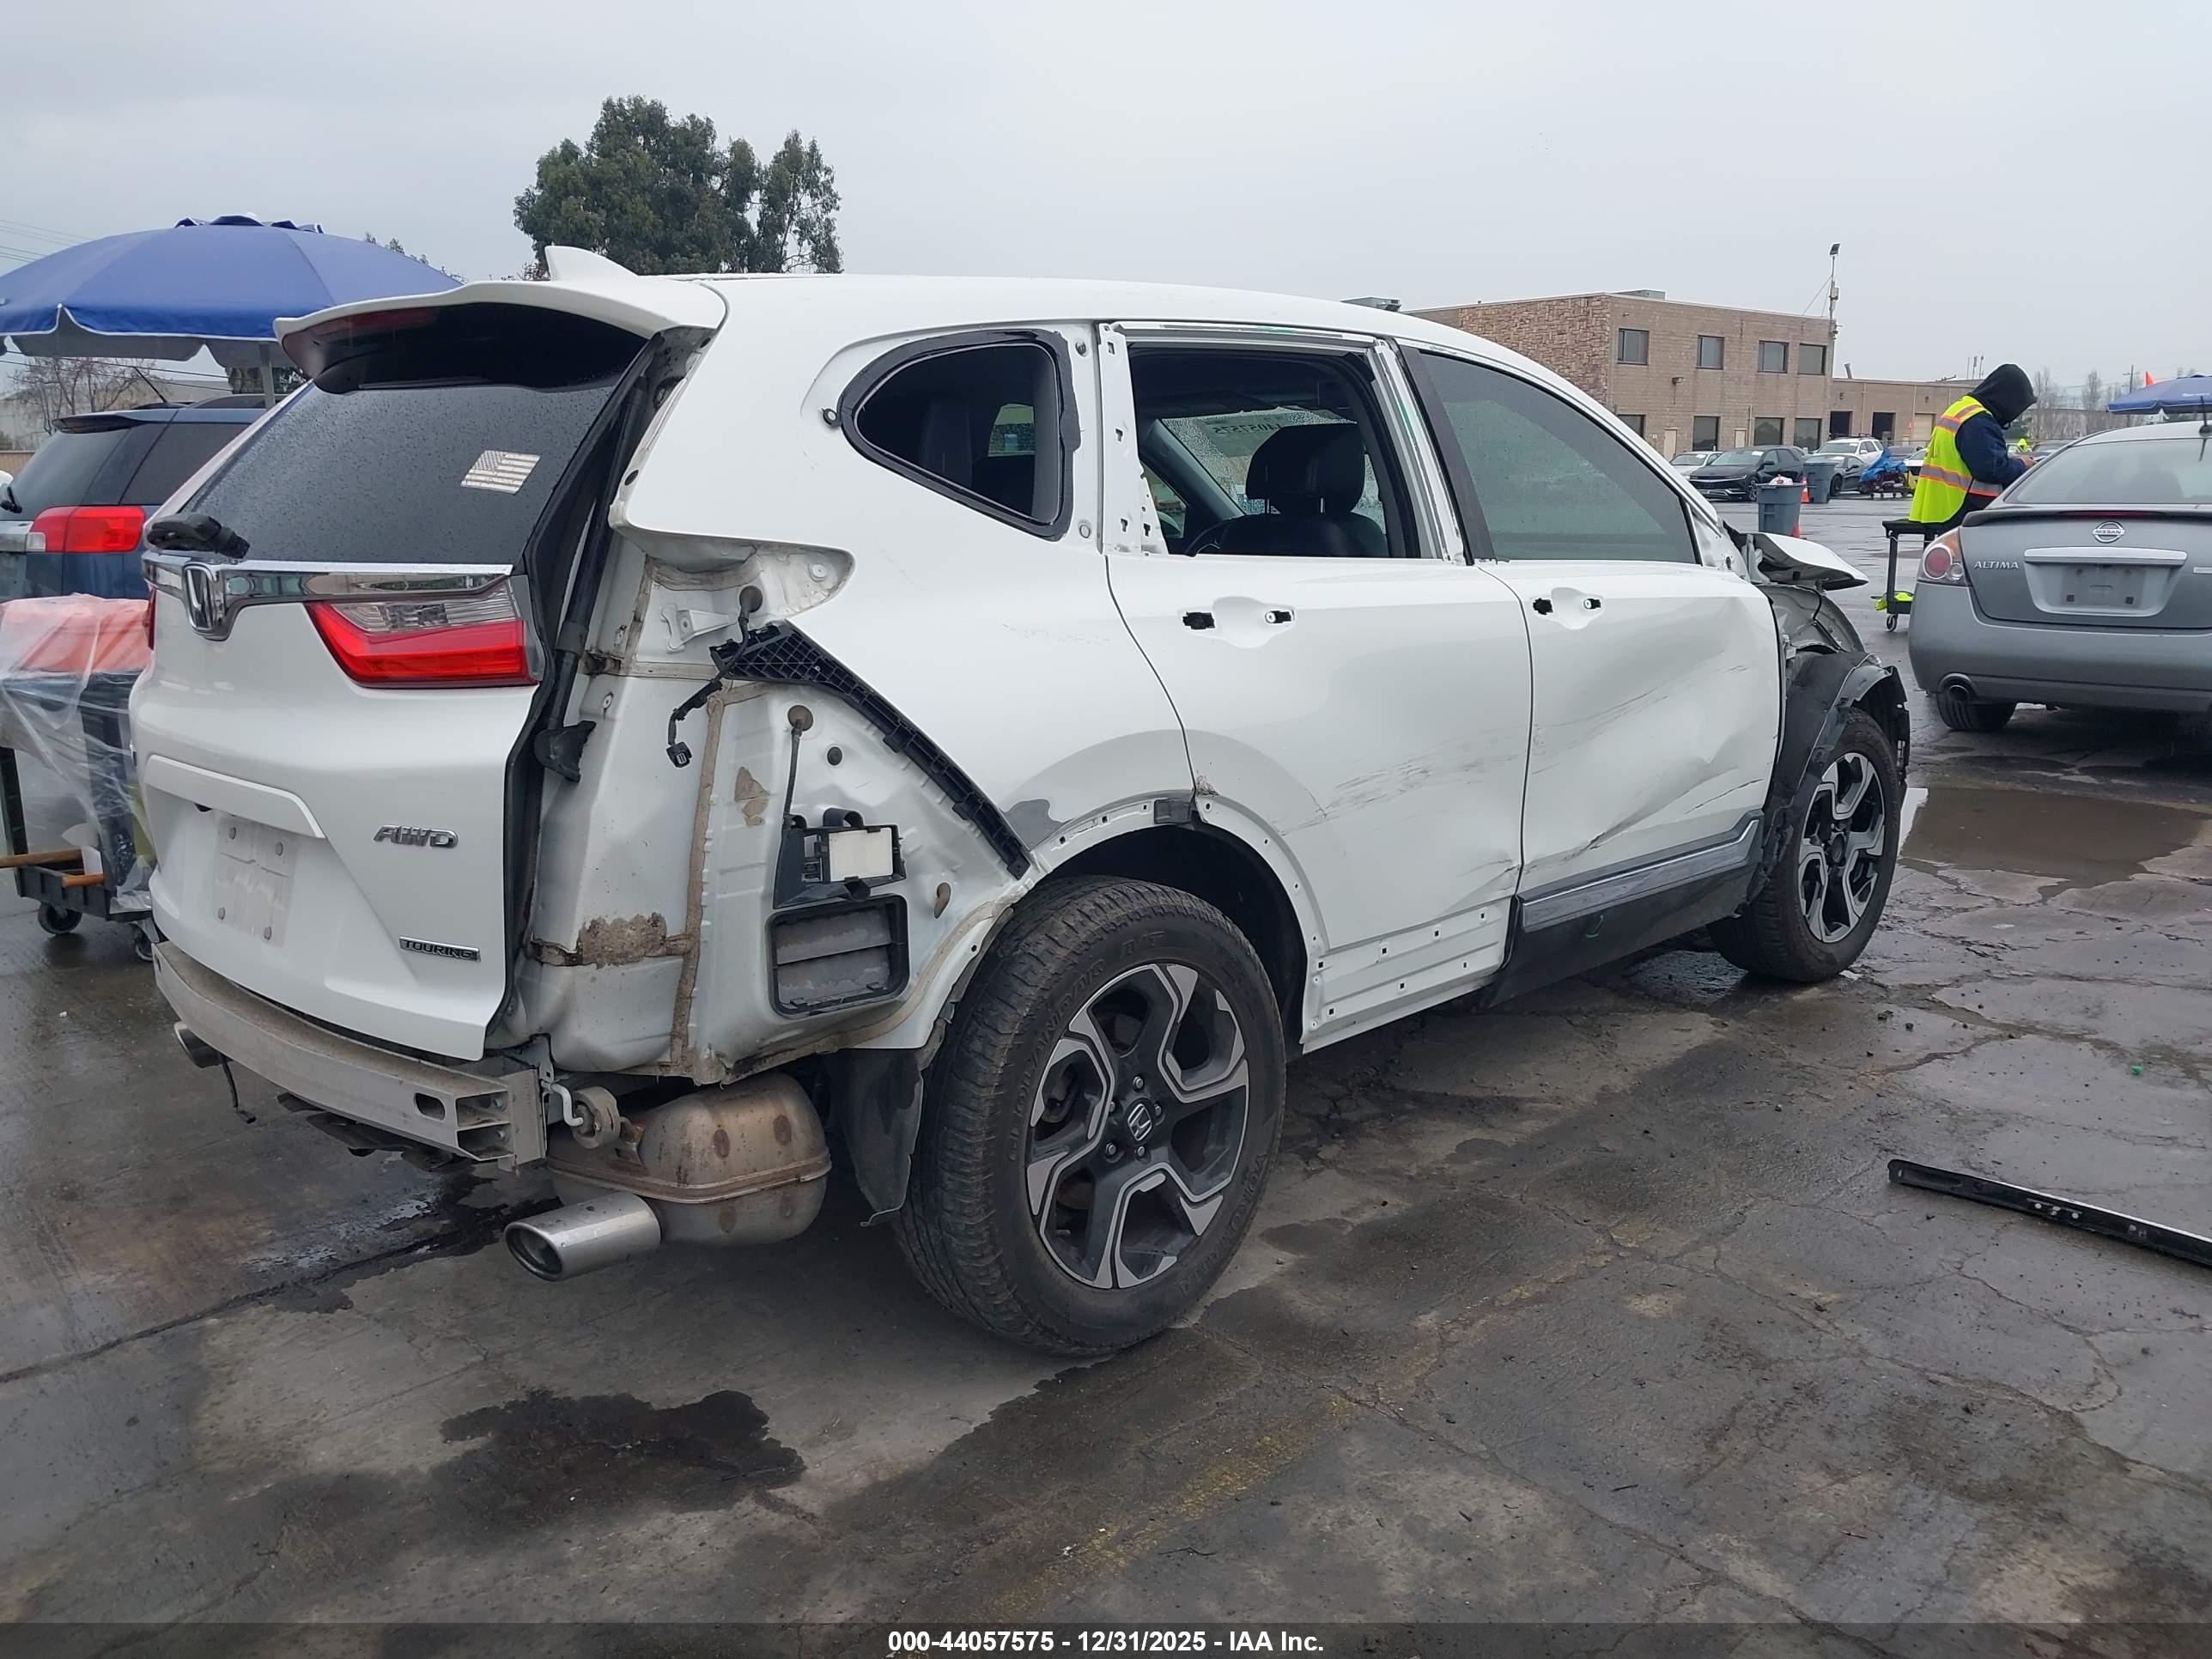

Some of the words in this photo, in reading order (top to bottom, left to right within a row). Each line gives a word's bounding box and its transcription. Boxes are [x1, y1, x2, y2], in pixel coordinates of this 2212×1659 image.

[1974, 561, 2019, 570] ALTIMA
[374, 824, 459, 848] AWD
[402, 939, 477, 962] TOURING
